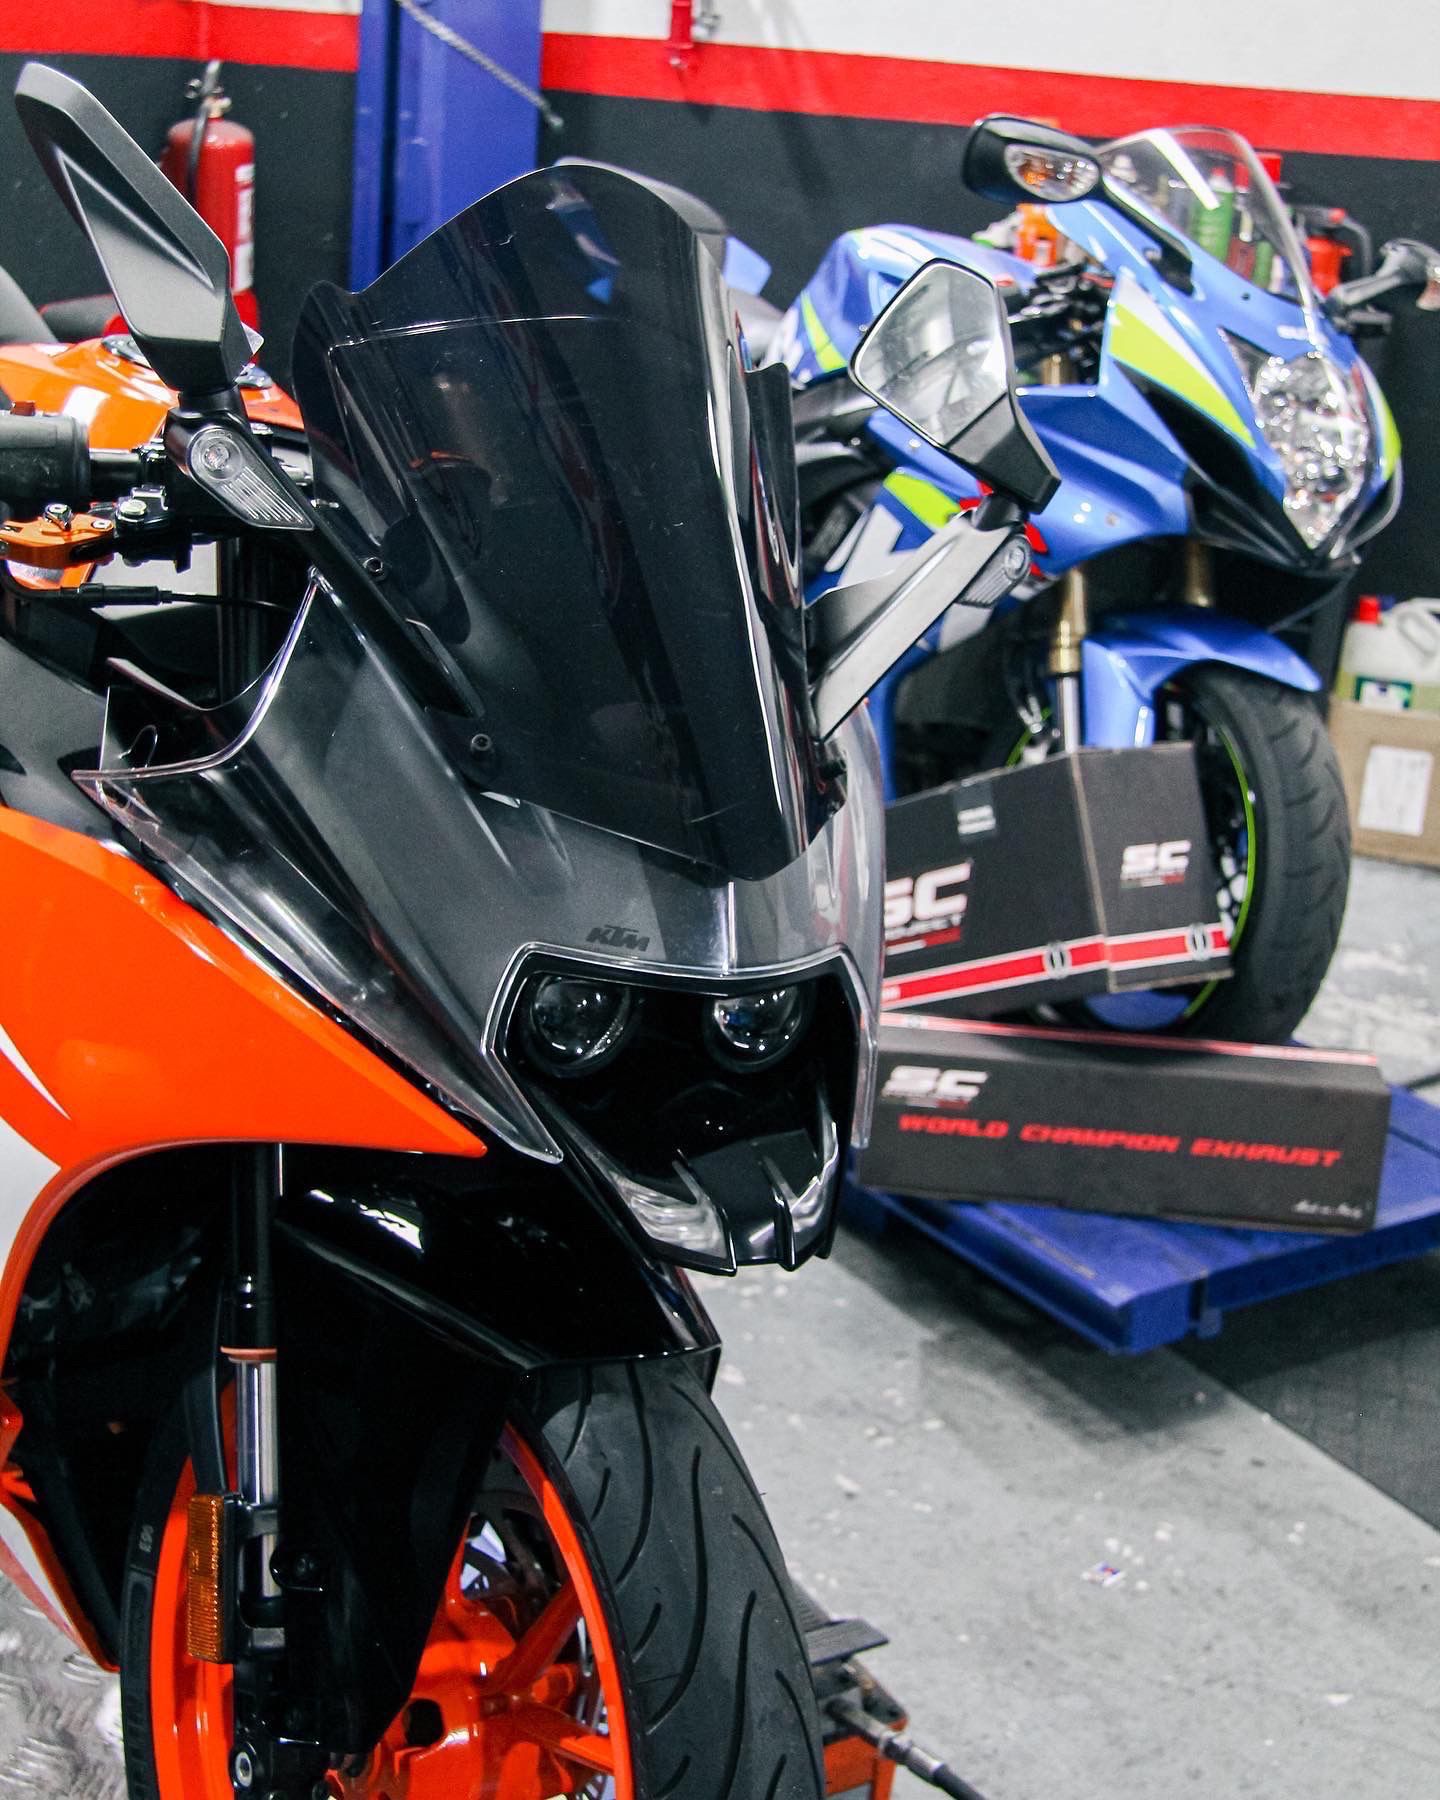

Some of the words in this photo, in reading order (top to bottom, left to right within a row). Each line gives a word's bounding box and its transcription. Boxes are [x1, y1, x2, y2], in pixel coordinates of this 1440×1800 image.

[1121, 840, 1192, 873] SC
[586, 924, 650, 952] KTM
[882, 1066, 989, 1098] SC
[898, 1114, 1009, 1138] WORLD
[1020, 1123, 1181, 1152] CHAMPION
[1190, 1137, 1342, 1167] EXHAUST
